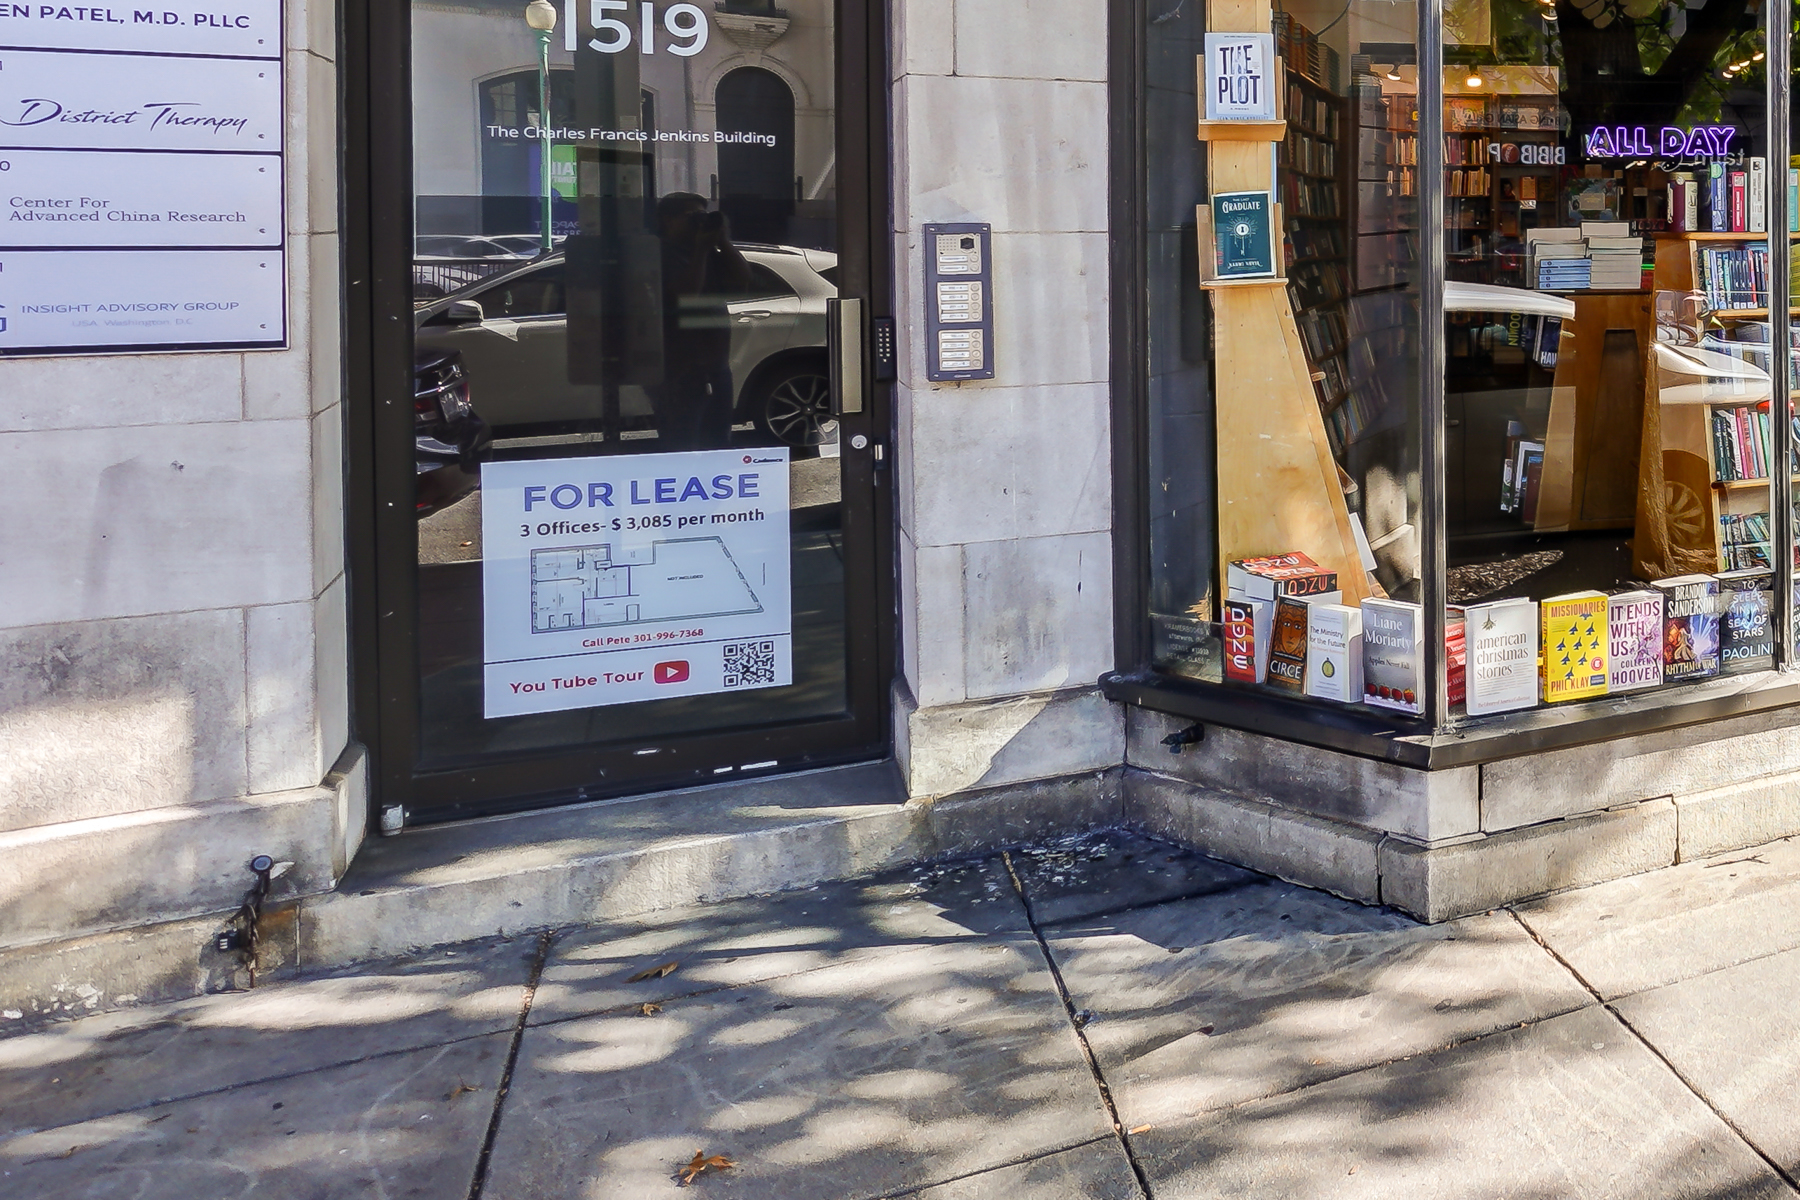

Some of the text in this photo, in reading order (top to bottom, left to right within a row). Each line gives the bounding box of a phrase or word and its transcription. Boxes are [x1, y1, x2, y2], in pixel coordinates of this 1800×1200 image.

[40, 6, 125, 24] PATEL,
[134, 10, 185, 27] M.D.
[194, 12, 250, 29] PLLC
[1219, 44, 1254, 75] THE
[1218, 75, 1261, 105] PLOT
[0, 98, 249, 136] District Therapy
[486, 124, 776, 147] The Charles Francis Jenkins Building
[1587, 126, 1653, 156] ALL
[1661, 126, 1736, 157] DAY
[9, 196, 110, 208] Center For
[1222, 200, 1261, 214] GRADUATE
[9, 211, 246, 222] Advanced China Research
[21, 302, 240, 313] INSIGHT ADVISORY GROUP
[524, 473, 760, 512] FOR LEASE
[520, 508, 765, 537] 3 Offices- $ 3,085 per month
[1675, 583, 1707, 601] BRANDON
[1742, 580, 1755, 590] TO
[1551, 600, 1606, 618] MISSIONARIES
[1610, 601, 1660, 621] IT ENDS
[1668, 596, 1715, 619] SANDERSON
[1373, 613, 1403, 631] Liane
[1754, 614, 1768, 625] OF
[582, 628, 704, 648] Call Pete 301-996-7368
[1231, 607, 1248, 670] DUNE
[1310, 625, 1344, 639] The Ministry
[1610, 620, 1645, 639] WITH
[1732, 627, 1764, 640] STARS
[1327, 638, 1346, 649] Future
[1365, 629, 1412, 654] Moriarty
[1476, 632, 1527, 650] american
[1611, 641, 1629, 657] US
[1476, 647, 1529, 665] christmas
[1722, 642, 1774, 661] PAOLINI
[1269, 660, 1303, 680] CIRCE
[1476, 662, 1513, 680] stories
[1612, 666, 1659, 685] HOOVER
[1665, 661, 1695, 676] RHYTHM
[509, 671, 645, 694] You Tube Tour
[1551, 676, 1590, 692] PHIL KLAY
